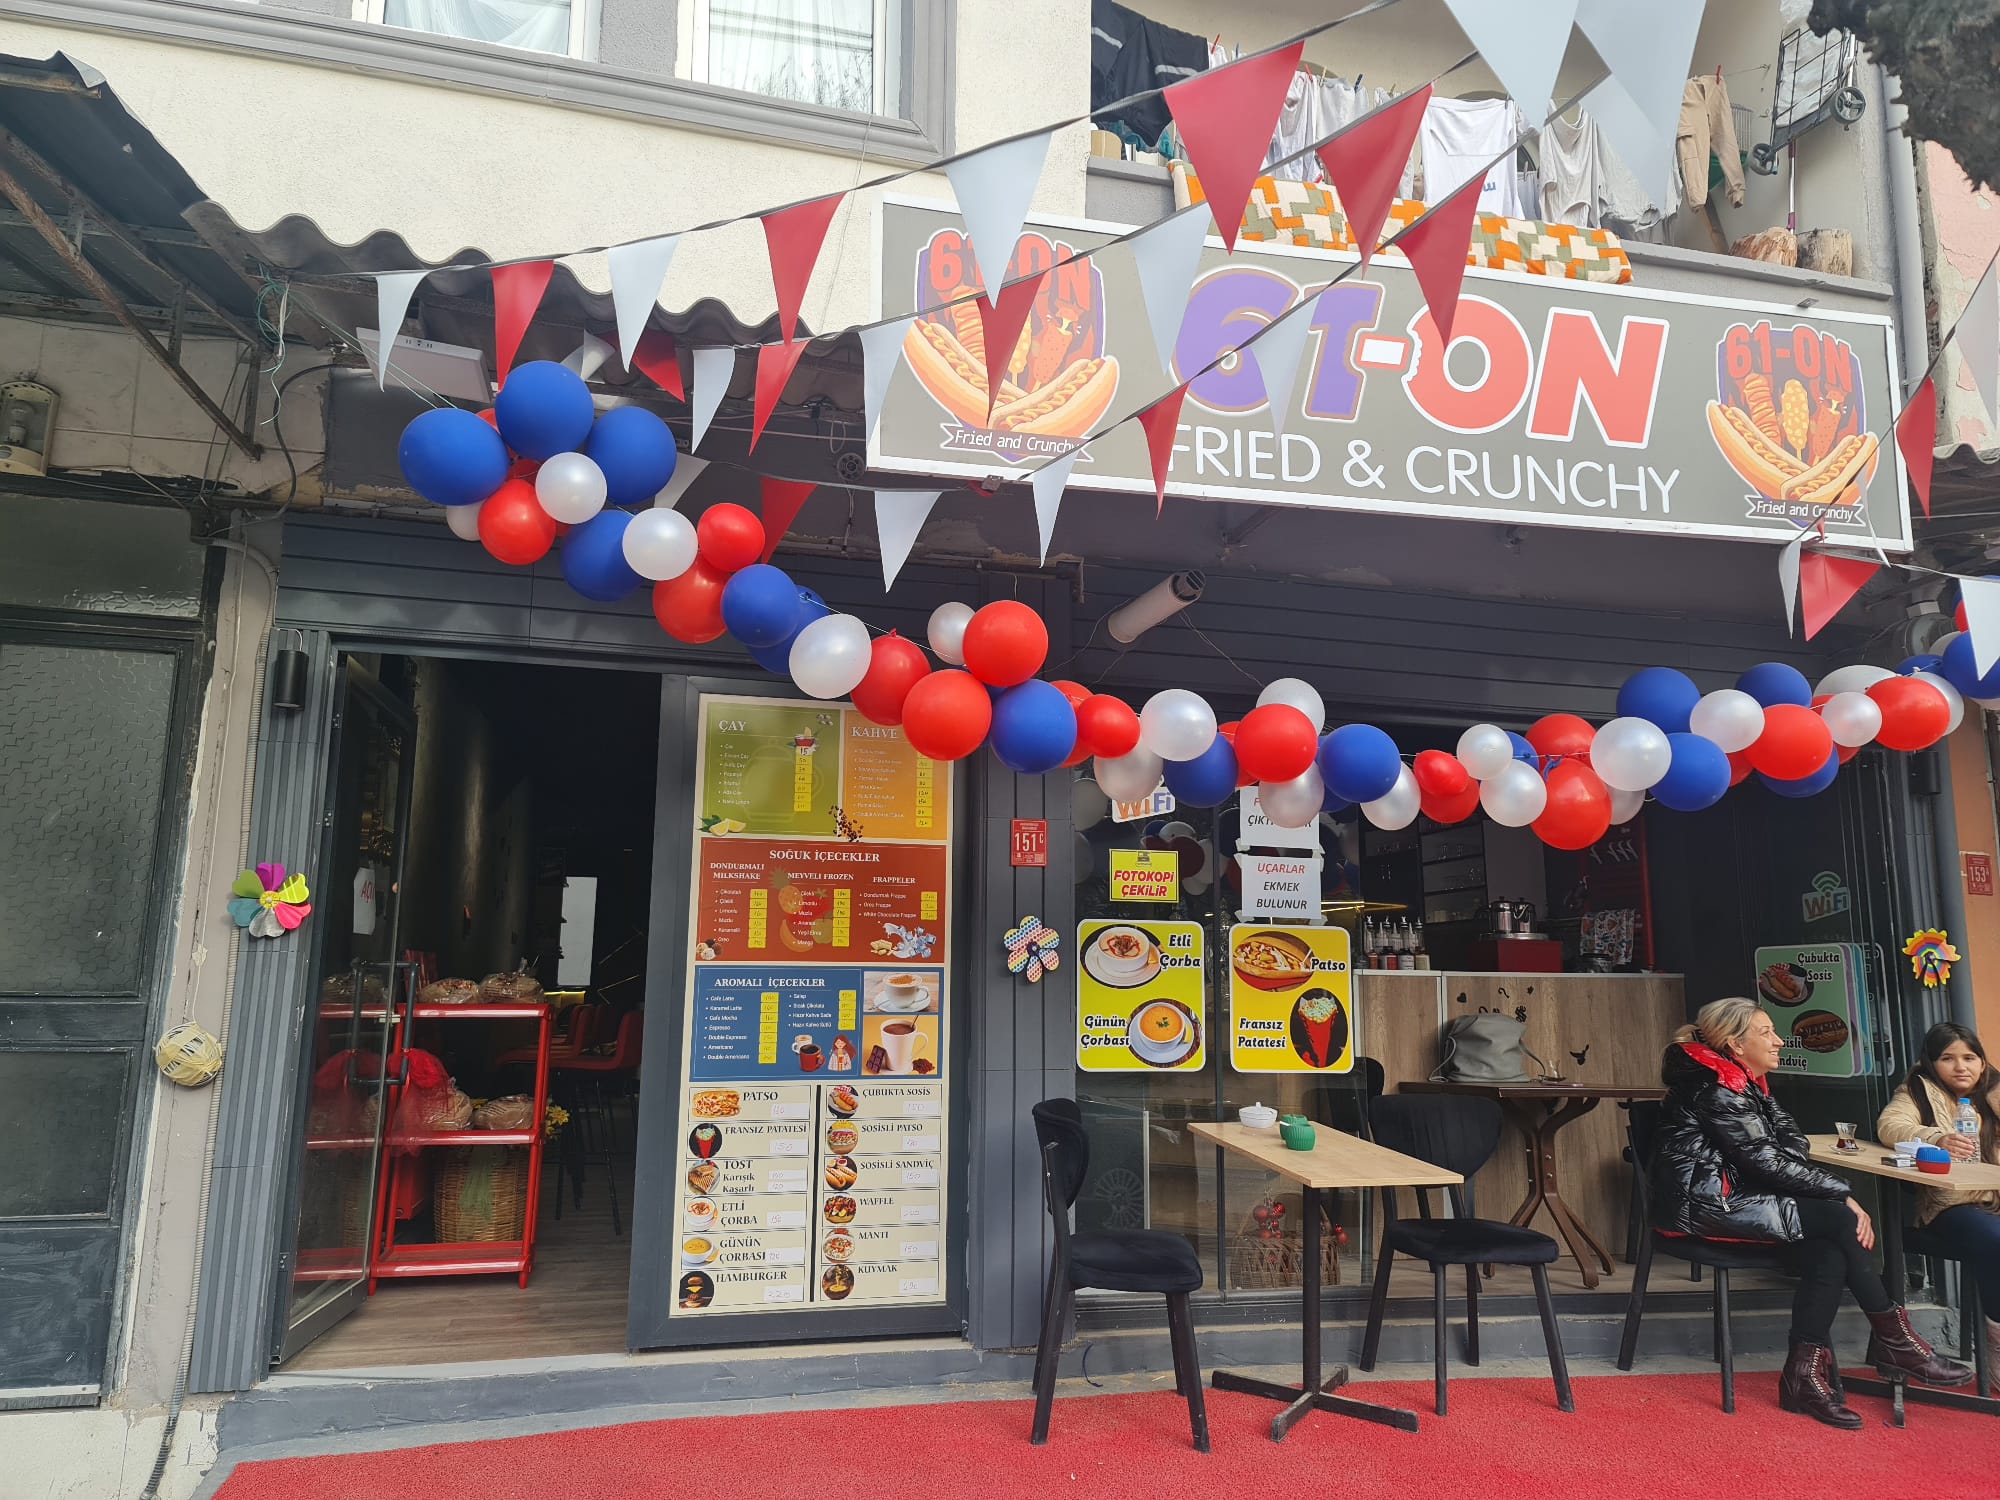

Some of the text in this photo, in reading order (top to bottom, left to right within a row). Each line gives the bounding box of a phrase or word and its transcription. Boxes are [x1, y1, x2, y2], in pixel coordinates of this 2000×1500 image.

[929, 230, 1091, 311] 6ON
[1170, 265, 1669, 449] 61-ON
[1725, 321, 1853, 393] 61-ON
[955, 430, 993, 447] Fried
[997, 434, 1022, 449] and
[1167, 424, 1680, 513] FRIED & CRUNCHY
[1756, 500, 1786, 515] Fried
[1789, 504, 1809, 517] and
[719, 720, 747, 733] ÇAY
[851, 726, 897, 739] KAHVE
[1014, 832, 1036, 852] 151
[769, 848, 881, 863] SOĞUK İÇECEKLER
[1257, 862, 1306, 875] UÇARLAR
[1969, 866, 1986, 883] 153
[823, 873, 854, 881] FROZEN
[872, 876, 916, 884] FRAPPELER
[1263, 881, 1300, 892] EKMEK
[1256, 898, 1308, 910] BULUNUR
[1803, 891, 1848, 919] WiFi
[1168, 934, 1192, 947] Etli
[1160, 954, 1201, 970] Çorba
[1311, 958, 1346, 971] Patso
[1797, 952, 1841, 967] Çubukta
[1807, 969, 1833, 981] Sosis
[714, 976, 825, 988] AROMALI İÇECEKLER
[1084, 1015, 1126, 1027] Günün
[1239, 1018, 1284, 1030] Fransız
[1080, 1034, 1130, 1049] Çorbası
[1237, 1036, 1286, 1048] Patatesi
[1782, 1036, 1802, 1049] sisli
[1778, 1056, 1808, 1071] ndviç
[742, 1091, 779, 1101] PATSO
[862, 1086, 931, 1098] ÇUBUKTA SOSİS
[725, 1123, 807, 1134] FRANSIZ PATATESİ
[861, 1122, 923, 1132] SOSİSLİ PATSO
[723, 1159, 754, 1170] TOST
[860, 1158, 935, 1169] SOSİSLİ SANDVİÇ
[723, 1172, 755, 1183] Karışık
[722, 1184, 755, 1194] Kaşarlı
[721, 1200, 745, 1212] ETLİ
[859, 1197, 894, 1206] WAFFLE
[720, 1215, 758, 1227] ÇORBA
[858, 1231, 889, 1240] MANTI
[719, 1236, 762, 1248] GÜNÜN
[719, 1251, 766, 1264] ÇORBASI
[858, 1264, 898, 1274] KUYMAK
[716, 1271, 788, 1283] HAMBURGER
